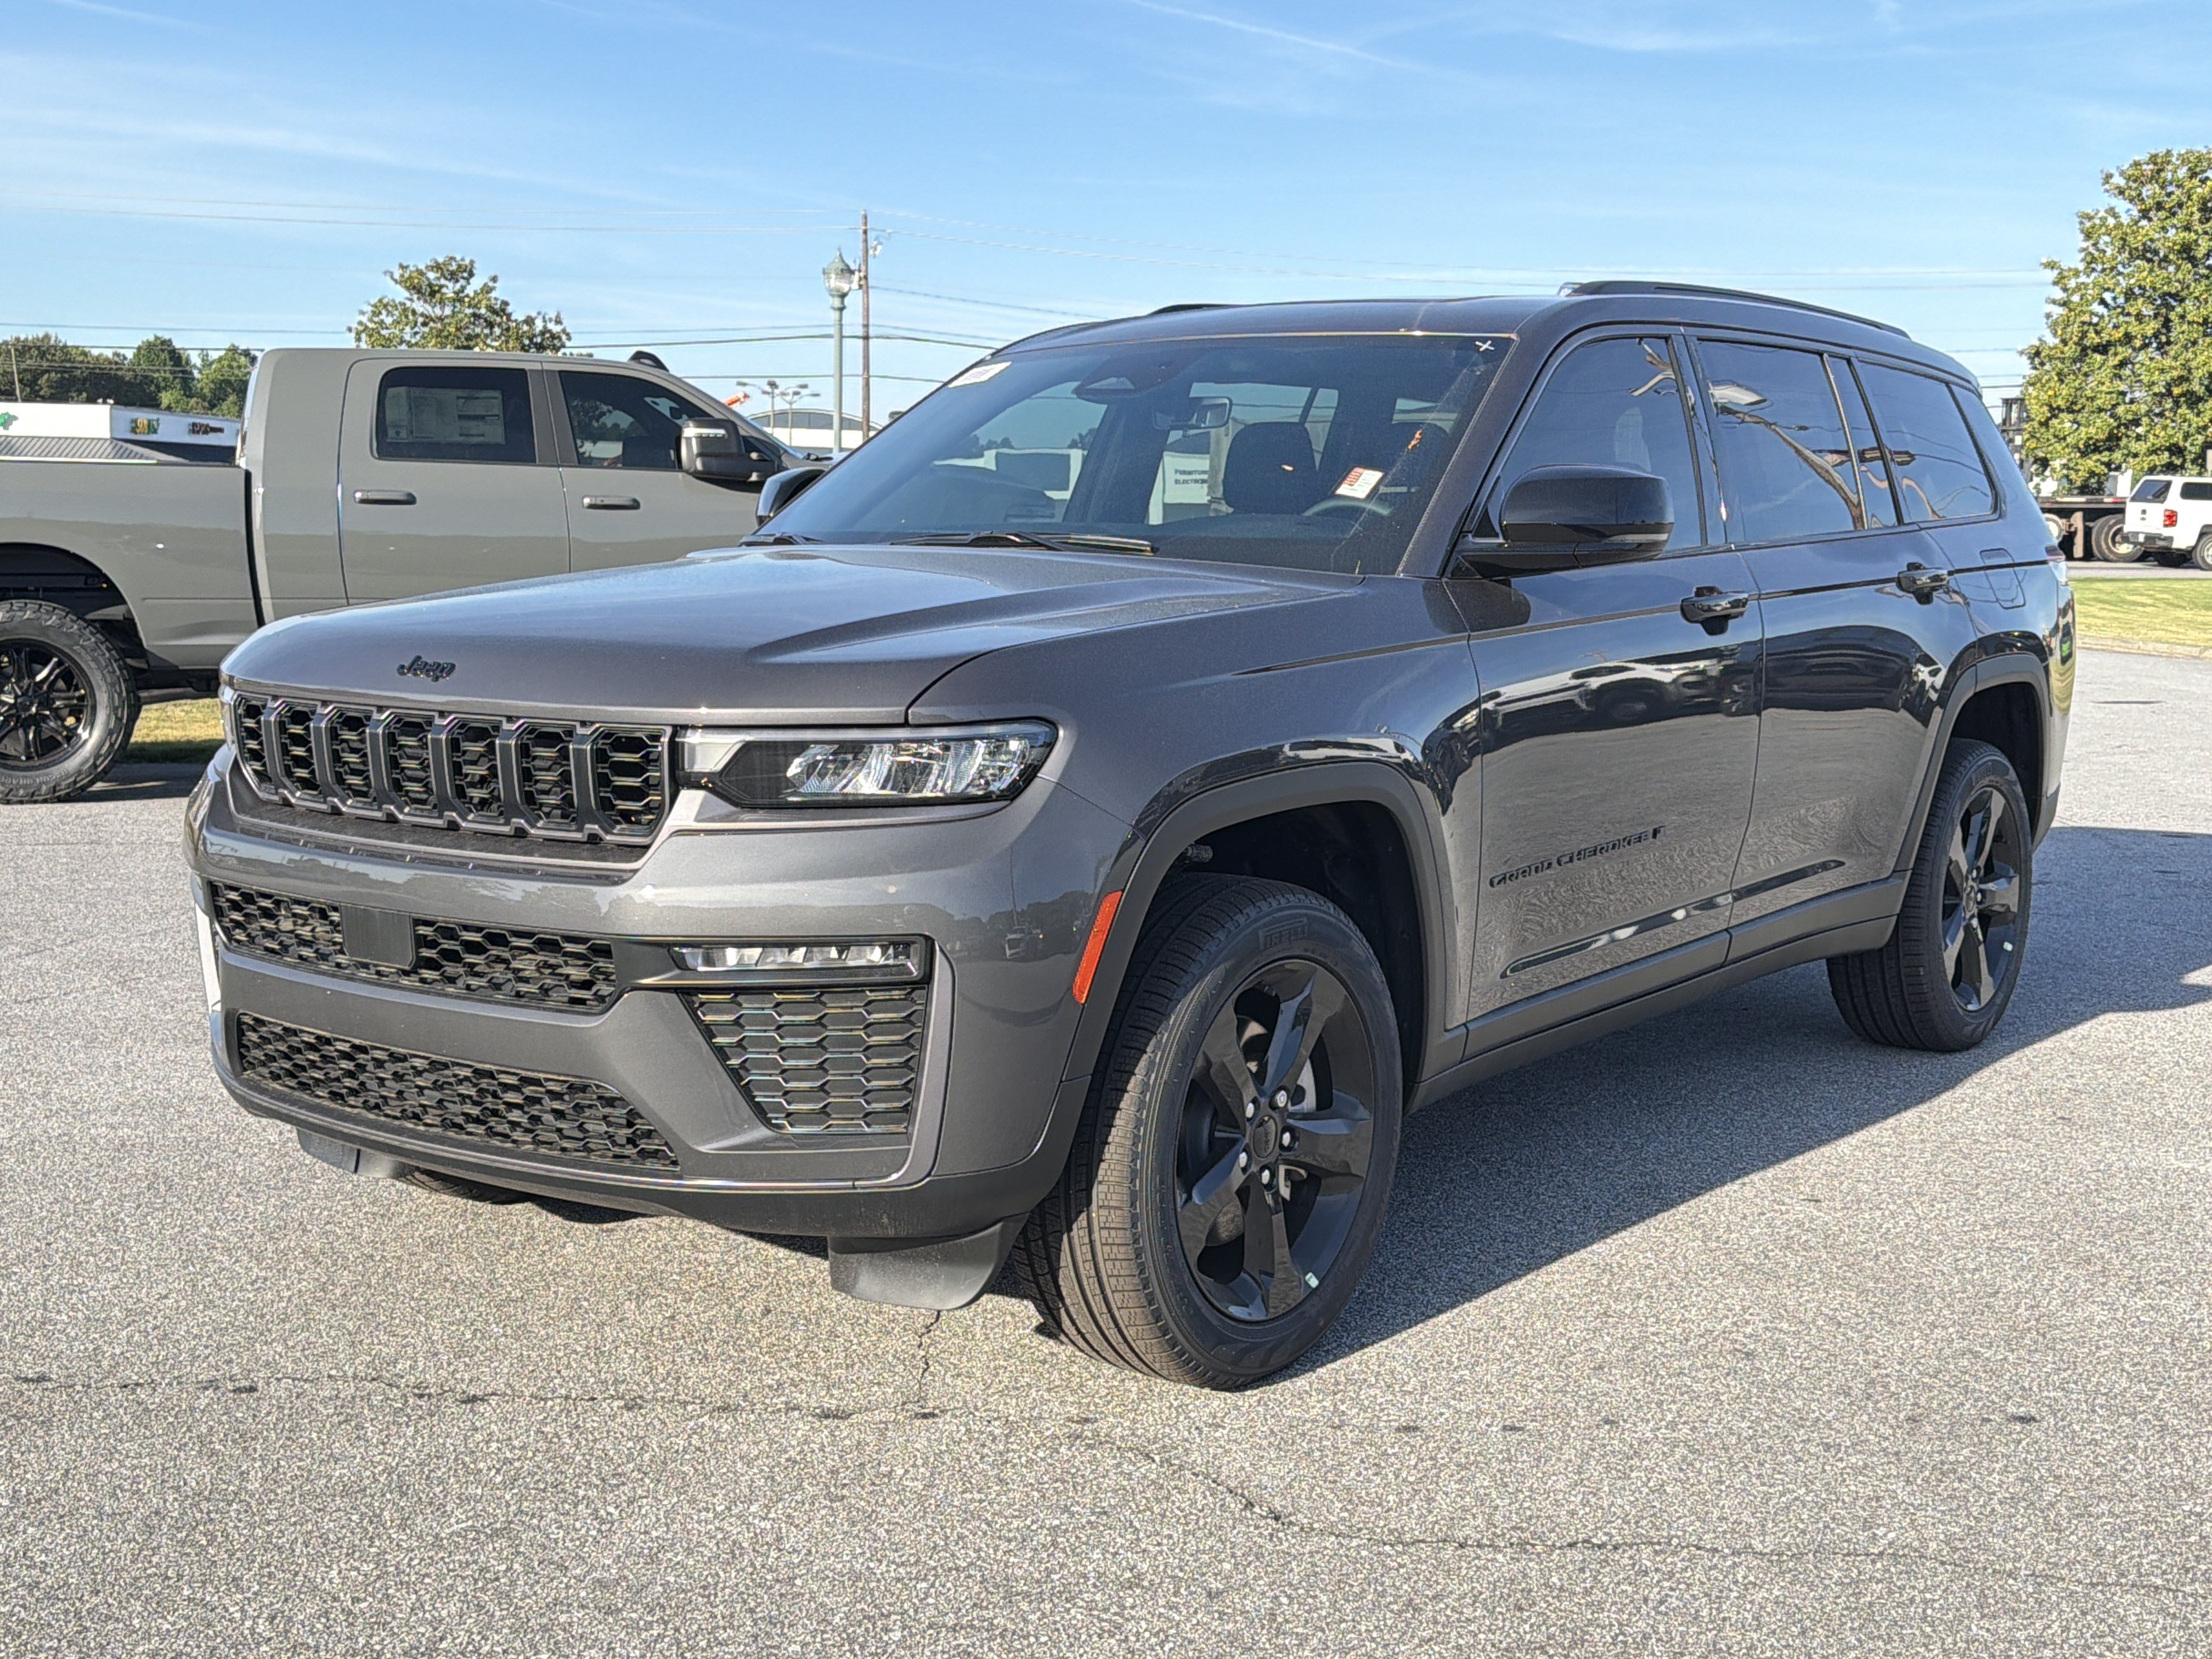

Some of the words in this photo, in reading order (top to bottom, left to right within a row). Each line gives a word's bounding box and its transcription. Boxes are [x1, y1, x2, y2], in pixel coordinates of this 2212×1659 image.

[397, 655, 456, 682] Jeep
[1489, 859, 1553, 888] GRAND
[1557, 830, 1650, 866] CHEROKEE
